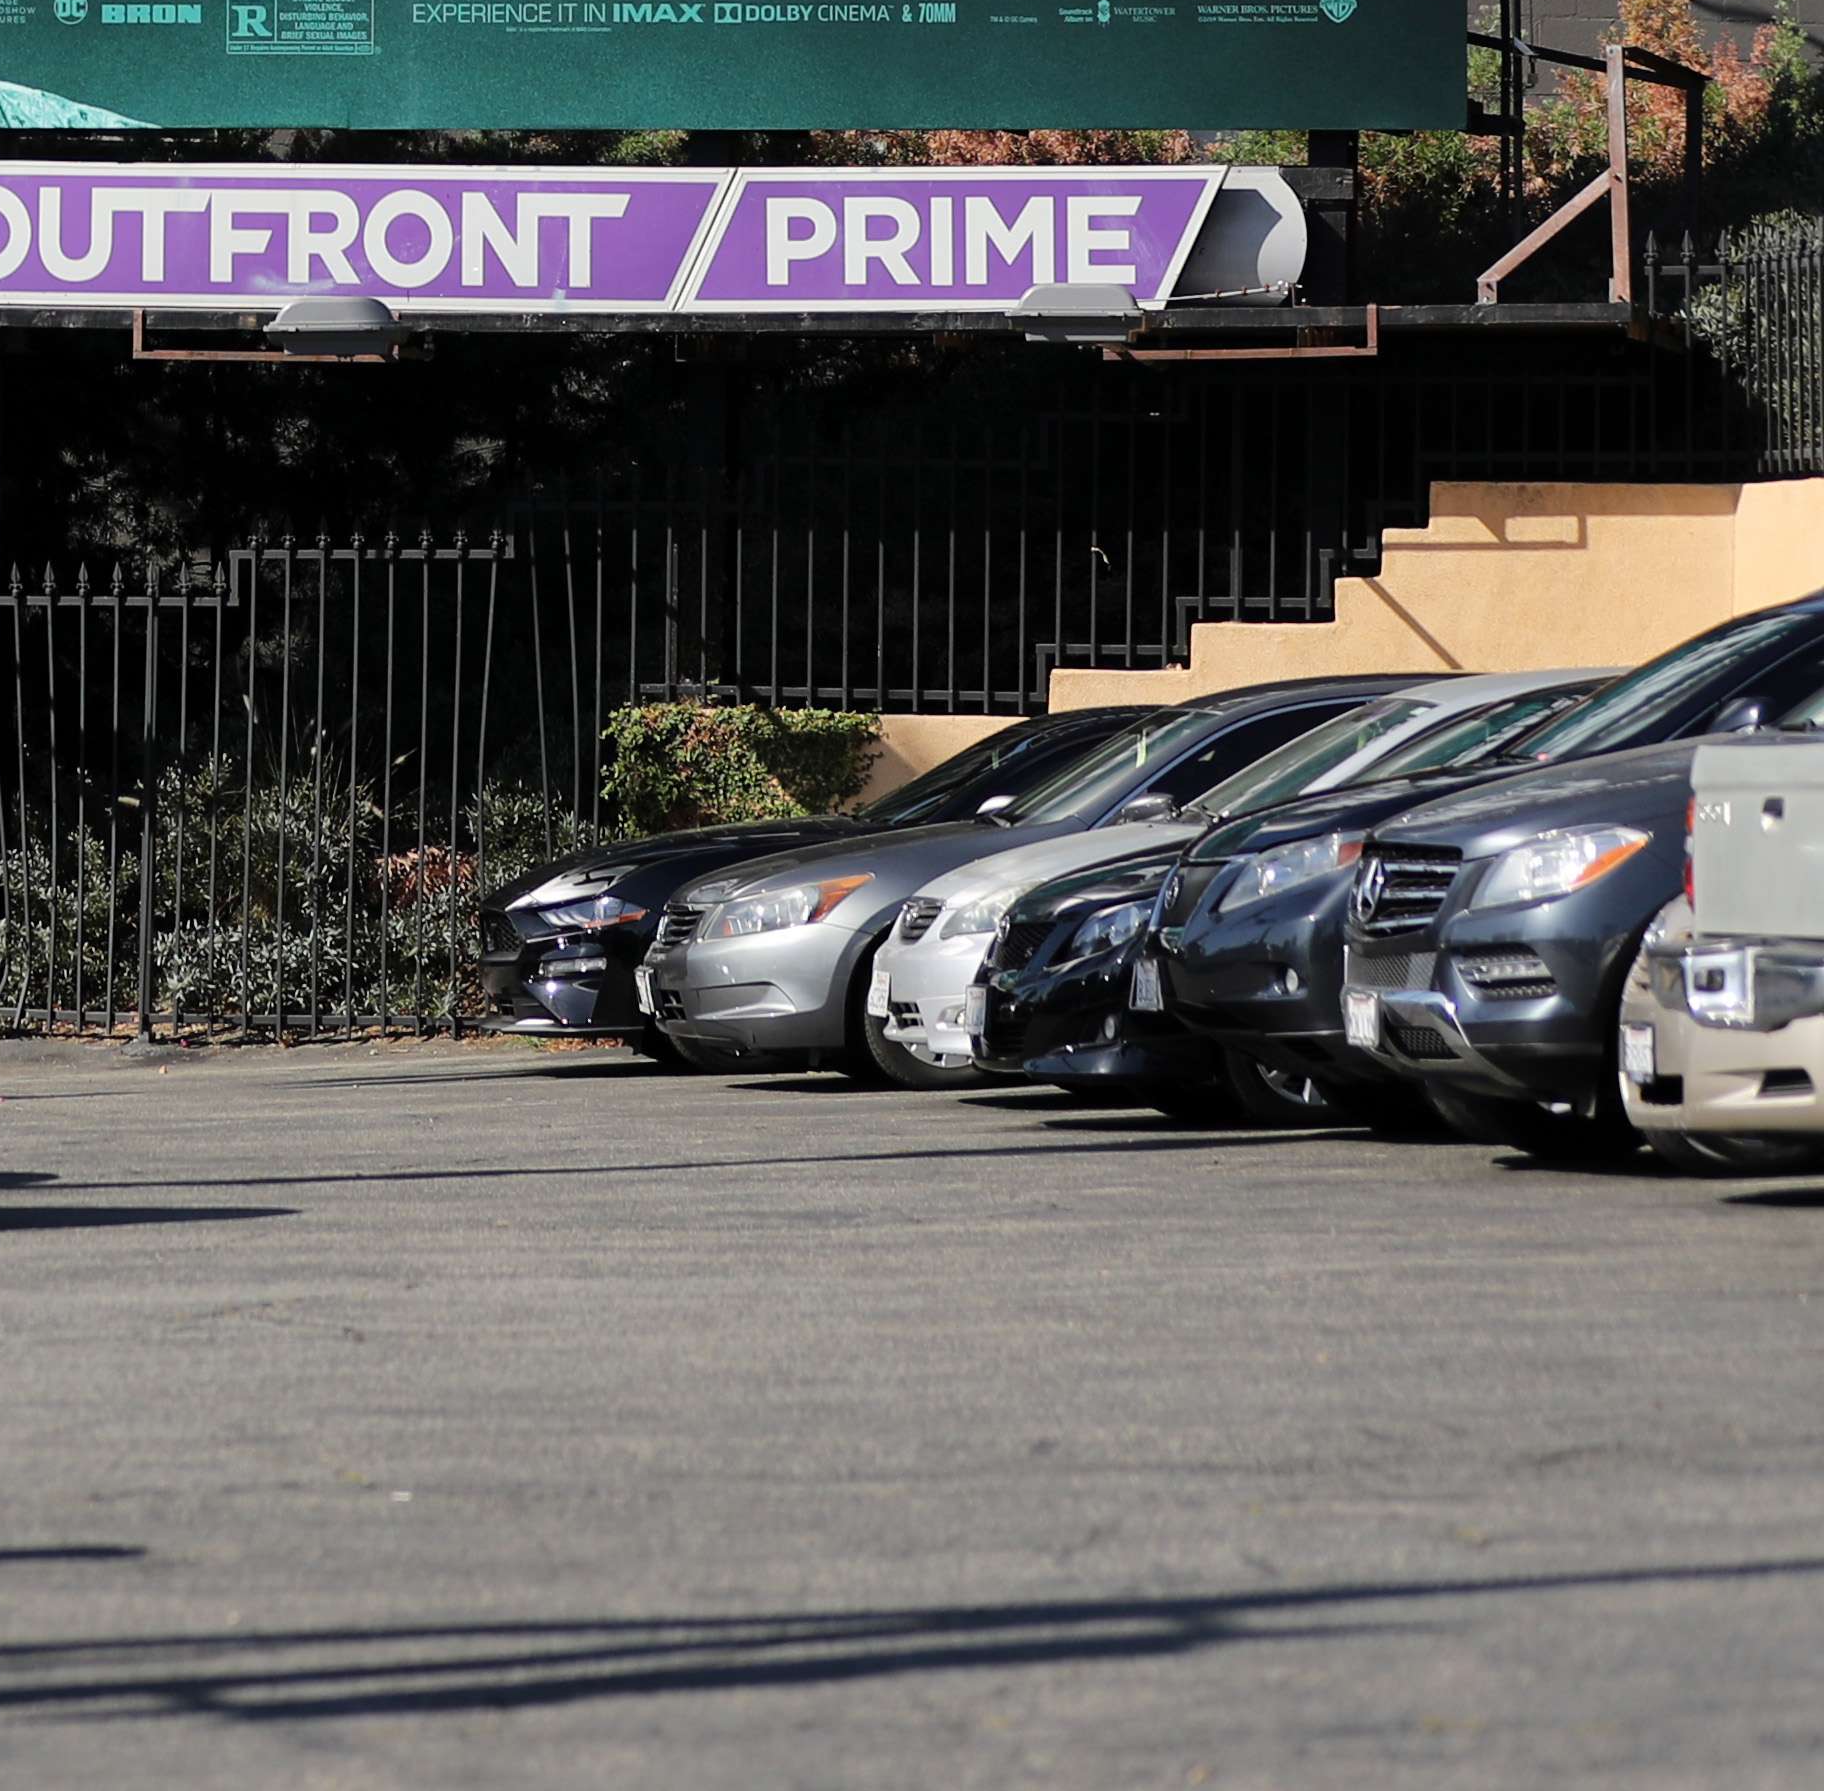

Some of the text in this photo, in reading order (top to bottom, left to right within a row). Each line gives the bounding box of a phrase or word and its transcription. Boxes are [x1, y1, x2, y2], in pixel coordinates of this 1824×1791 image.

[101, 4, 202, 24] BRON
[412, 3, 552, 23] EXPERIENCE
[558, 3, 578, 23] IT
[583, 3, 606, 23] IN
[612, 3, 704, 23] IMAX
[745, 4, 814, 22] DOLBY
[901, 4, 913, 23] &
[918, 2, 956, 23] 70MM
[1197, 5, 1239, 14] WARNER
[1270, 5, 1319, 14] PICTURES
[231, 5, 273, 37] R
[279, 13, 327, 21] DISTURBING
[294, 22, 335, 31] LANGUAGE
[305, 31, 335, 40] SEXUAL
[766, 195, 1145, 287] PRIME
